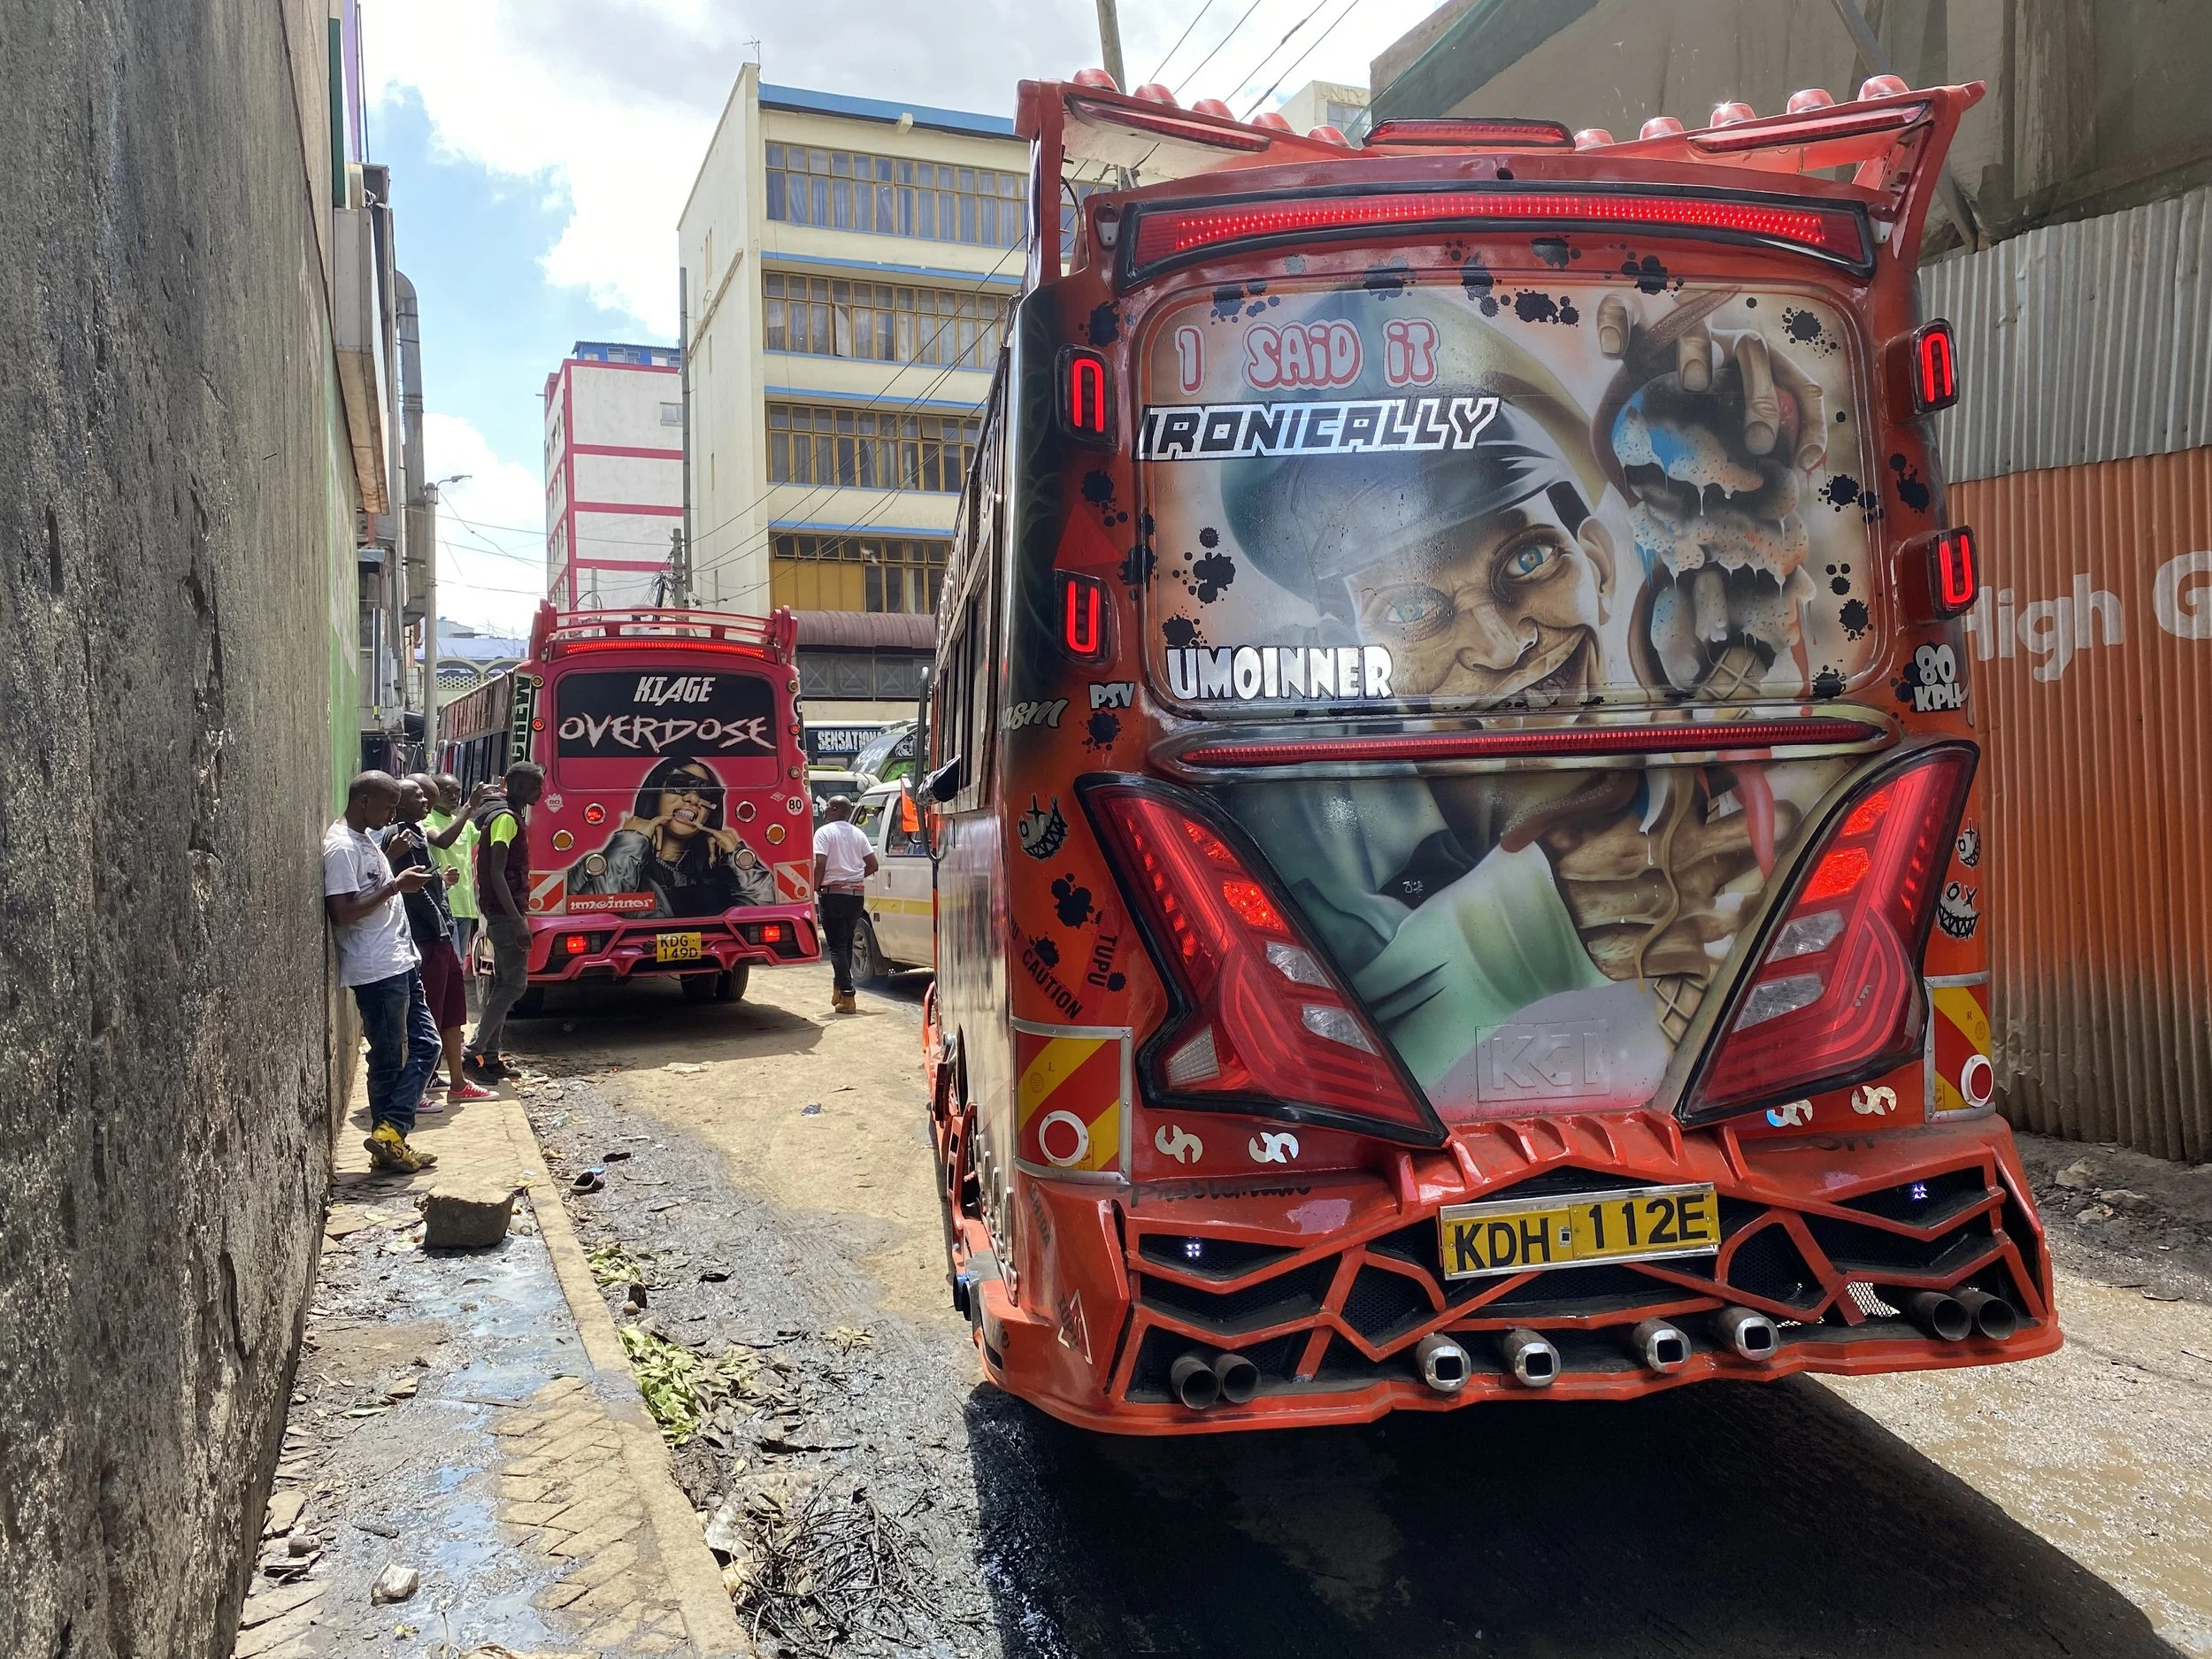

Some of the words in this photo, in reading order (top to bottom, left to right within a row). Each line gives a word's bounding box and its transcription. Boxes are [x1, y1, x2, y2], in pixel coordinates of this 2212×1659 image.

[1318, 85, 1365, 104] UNITY
[1136, 396, 1502, 460] IRONICALLY
[1166, 646, 1394, 700] UMOINNER
[1916, 643, 1956, 686] 80
[633, 676, 717, 706] KIAGE
[1089, 681, 1135, 709] PSV
[1914, 682, 1962, 711] KPH
[558, 711, 777, 753] OVERDOSE
[818, 730, 882, 751] SENSATION
[788, 799, 802, 810] 80
[660, 933, 688, 947] KDG
[664, 948, 698, 959] 149D
[1087, 934, 1118, 987] TUPU
[1022, 949, 1084, 1020] CAUTION
[1048, 1063, 1055, 1072] L
[1455, 1218, 1550, 1272] KDH
[1588, 1195, 1709, 1249] 112E
